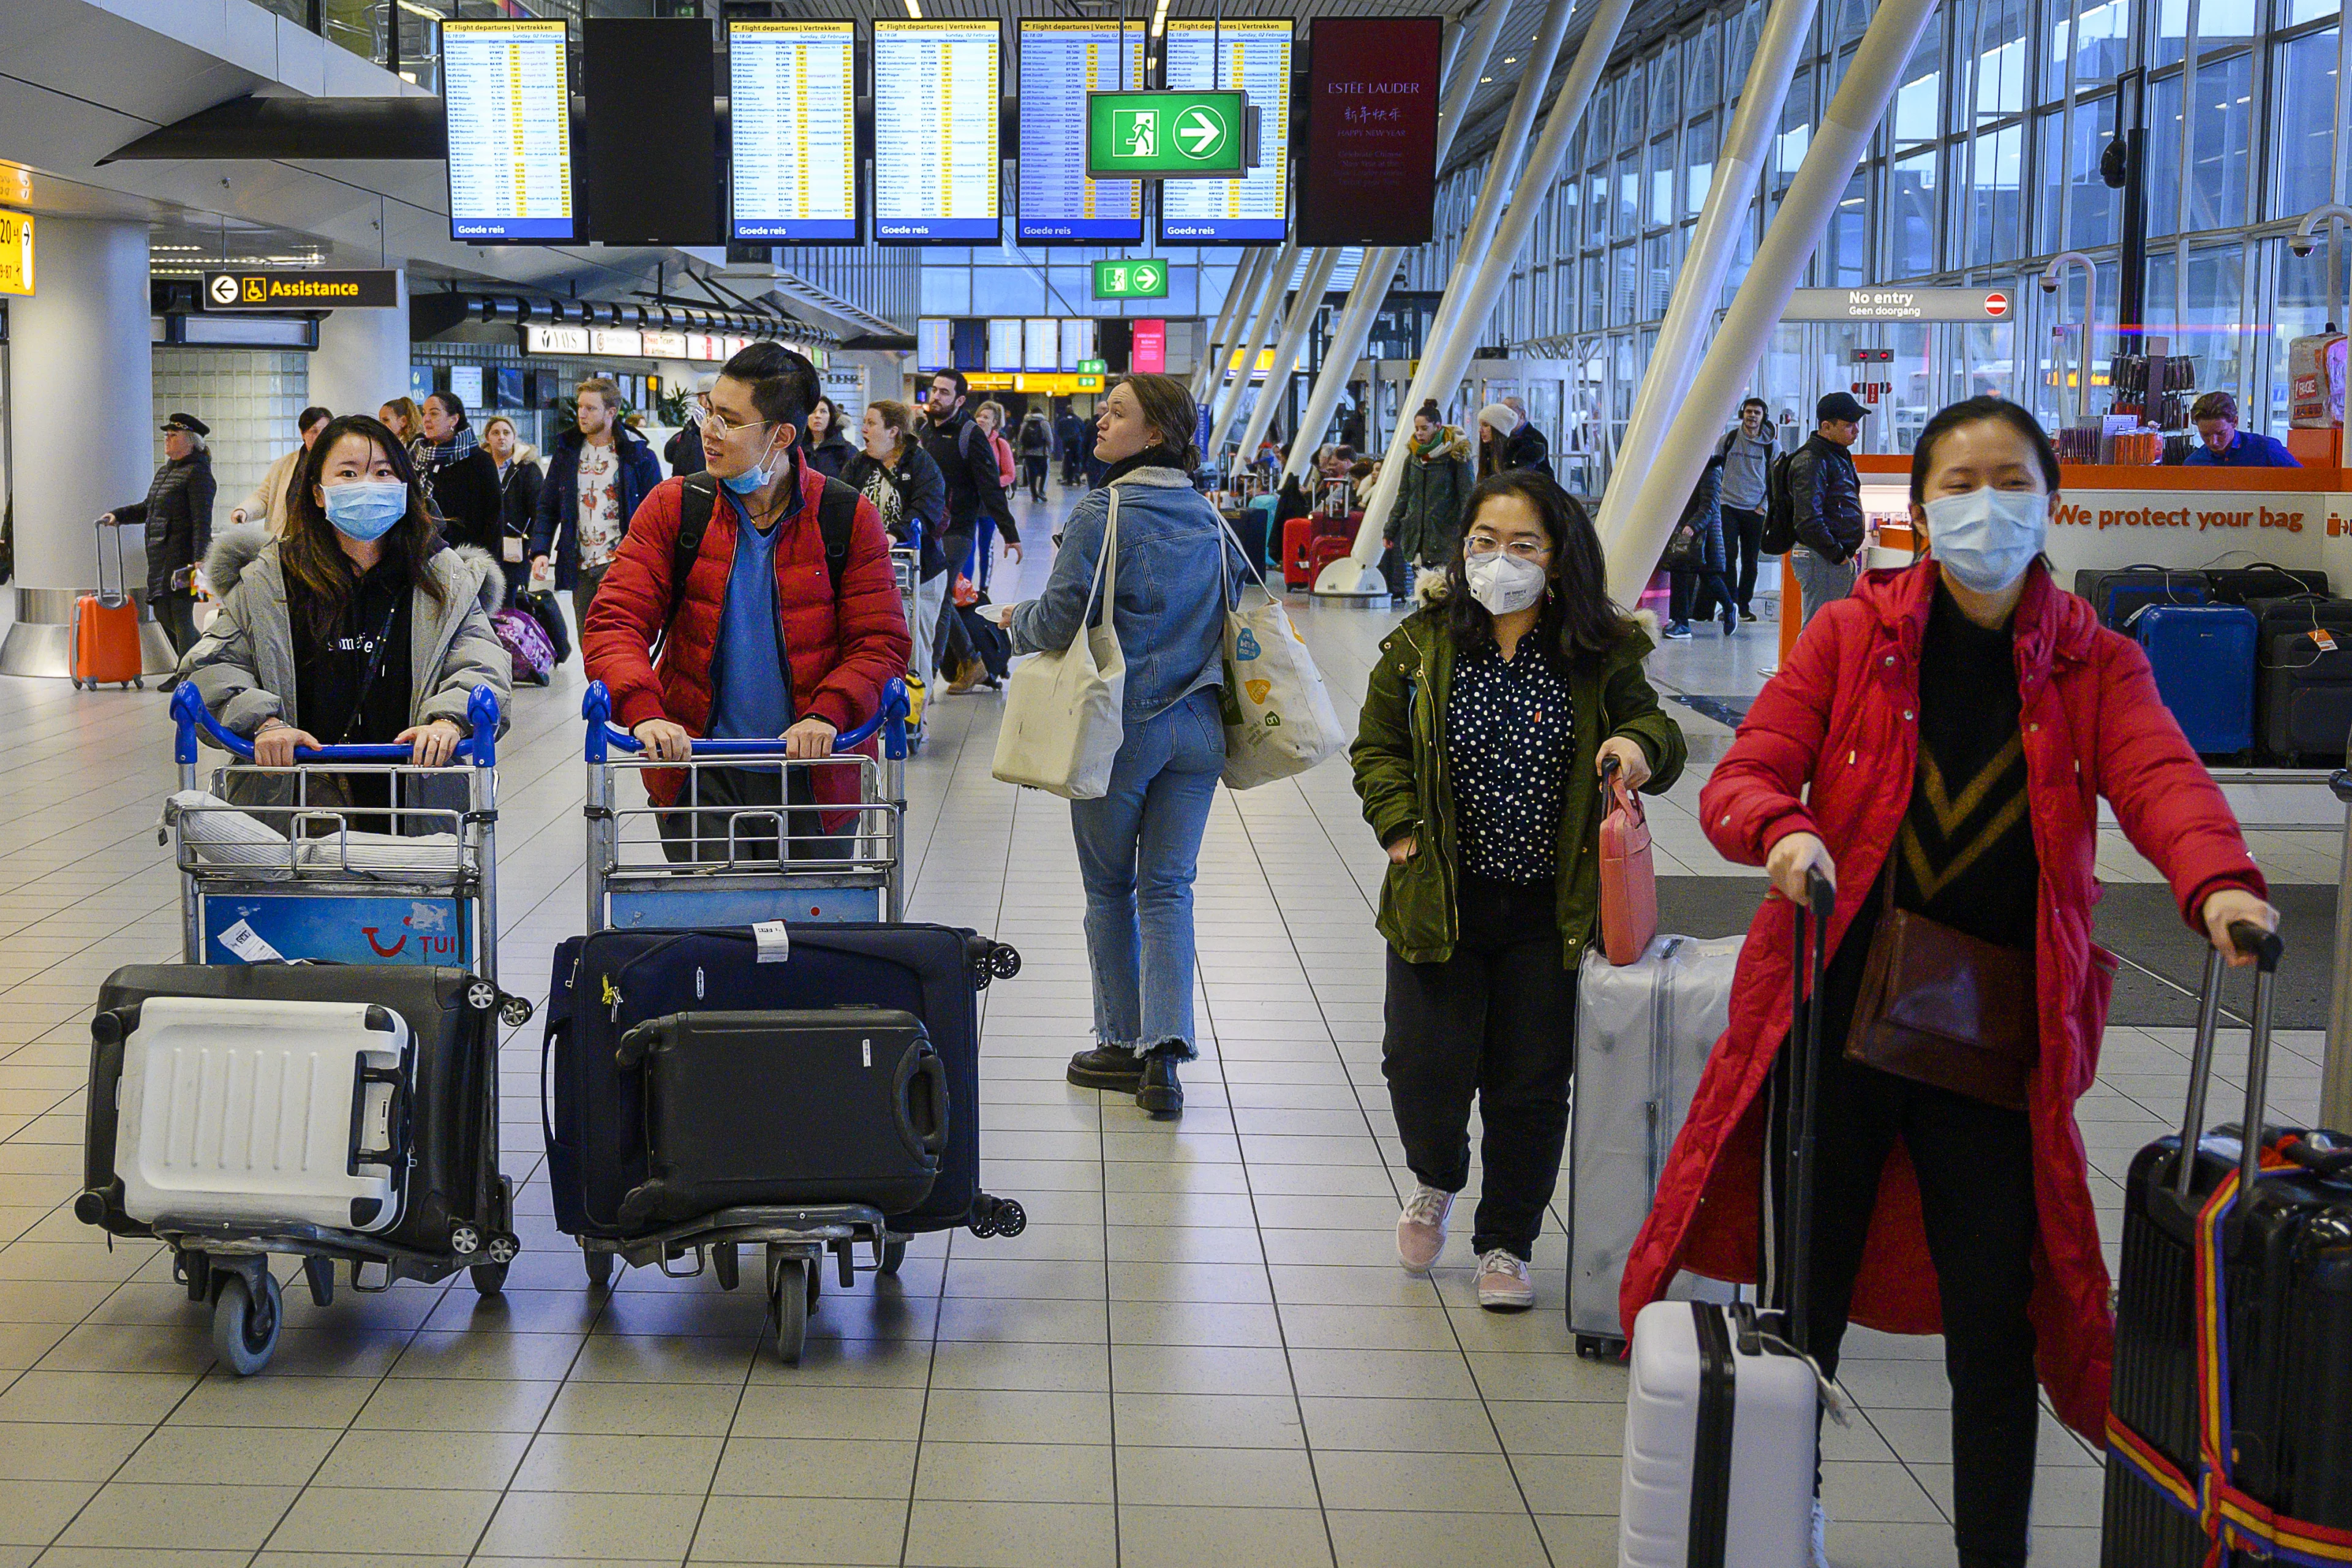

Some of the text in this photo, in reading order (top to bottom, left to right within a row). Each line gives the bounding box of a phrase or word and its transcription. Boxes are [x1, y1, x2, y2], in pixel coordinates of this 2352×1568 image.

[1369, 83, 1419, 94] LAUDER
[270, 279, 358, 296] Assistance
[1849, 292, 1913, 306] No entry
[1849, 306, 1920, 317] Geen doorgang
[2054, 505, 2304, 533] We protect your bag
[419, 936, 455, 953] TUI
